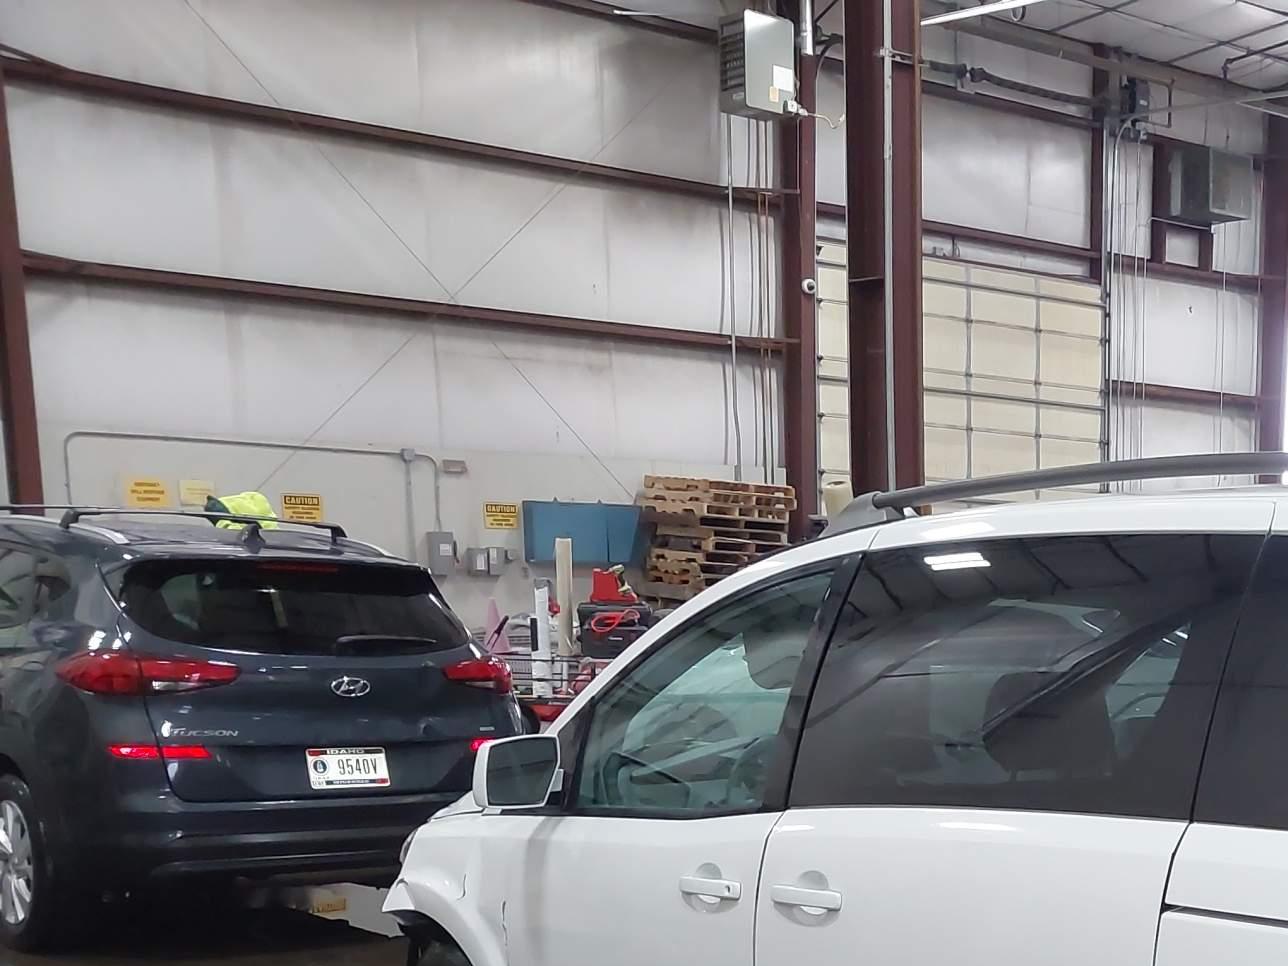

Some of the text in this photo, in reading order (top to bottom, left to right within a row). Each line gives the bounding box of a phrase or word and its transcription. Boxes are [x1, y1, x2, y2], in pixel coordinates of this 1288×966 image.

[286, 497, 318, 505] CAUTION
[487, 505, 516, 513] CAUTION
[171, 728, 239, 737] TUCSON
[338, 758, 377, 775] 9540V
